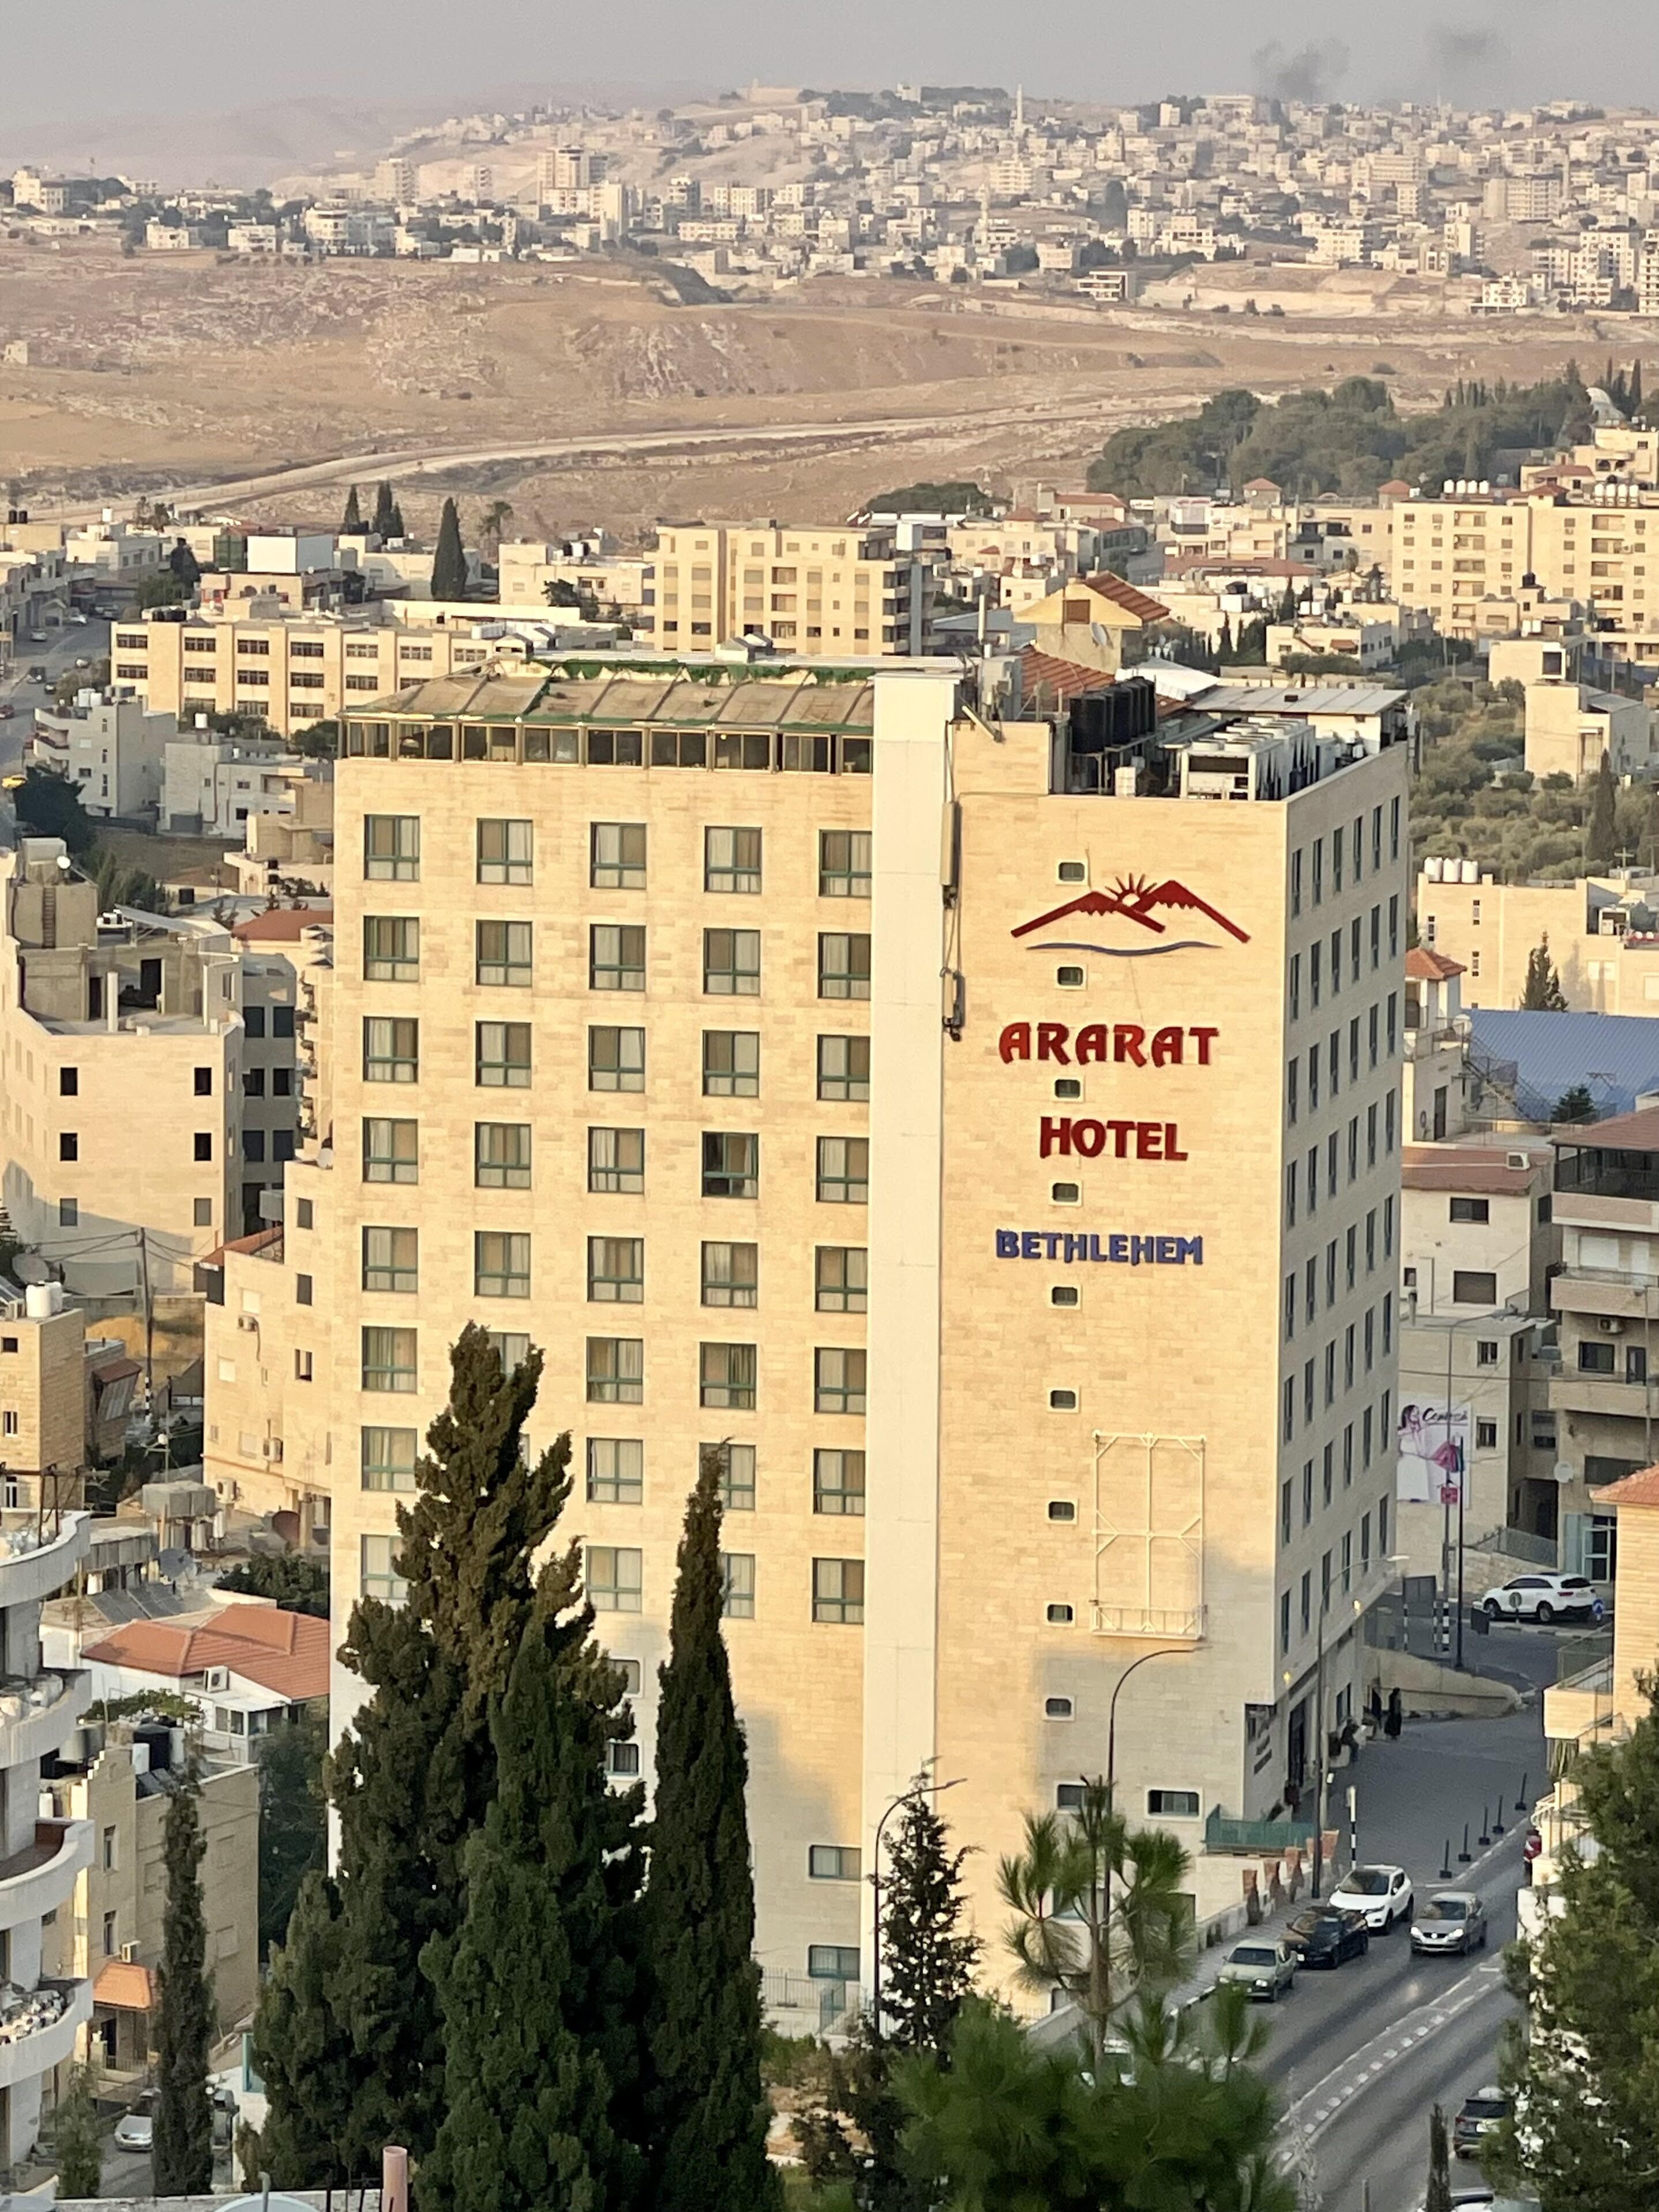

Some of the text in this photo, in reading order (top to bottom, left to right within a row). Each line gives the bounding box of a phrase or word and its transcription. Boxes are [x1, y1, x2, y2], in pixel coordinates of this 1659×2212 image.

[999, 1022, 1219, 1067] ARARAT
[1040, 1116, 1188, 1161] HOTEL
[996, 1229, 1203, 1265] BETHLEHEM
